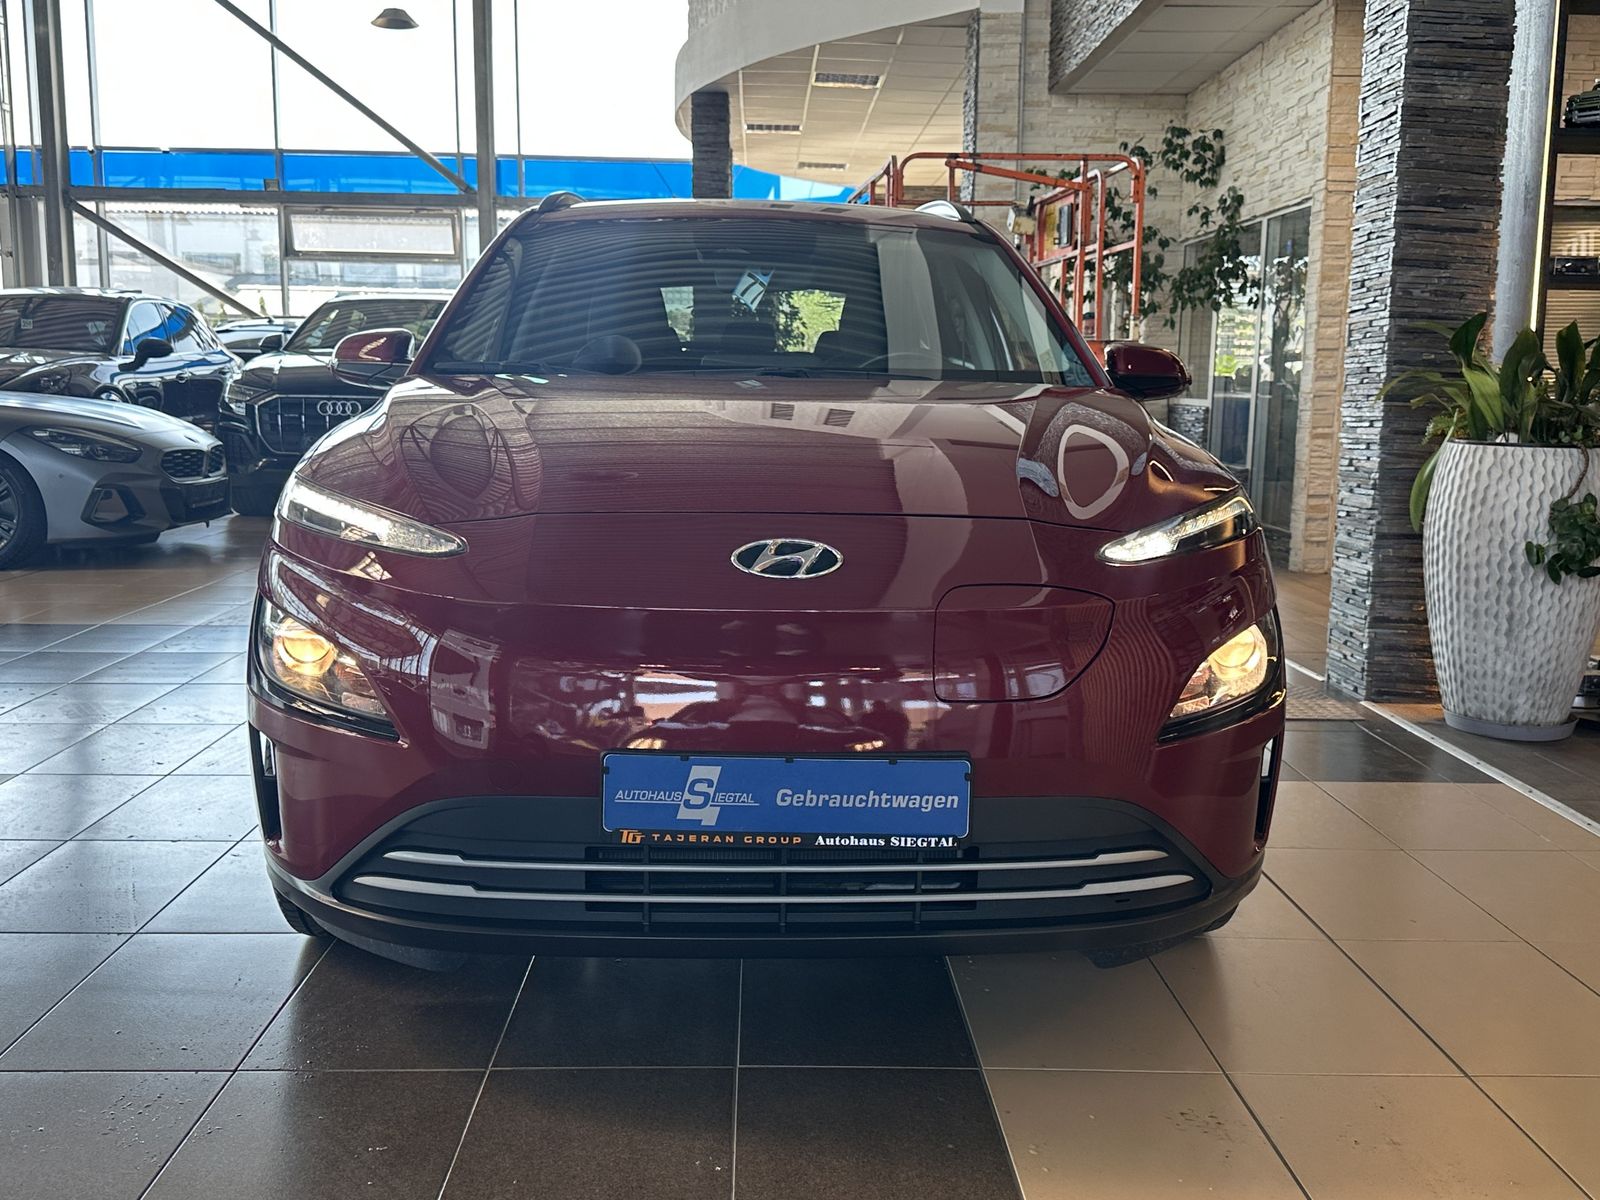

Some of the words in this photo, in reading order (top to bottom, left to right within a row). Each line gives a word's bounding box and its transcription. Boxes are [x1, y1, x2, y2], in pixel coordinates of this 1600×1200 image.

[615, 790, 682, 801] AUTOHAUS
[776, 789, 959, 812] Gebrauchtwagen
[652, 833, 734, 843] TAJERAN
[744, 836, 802, 845] GROUP
[815, 835, 889, 847] Autohaus
[890, 836, 957, 848] SIEGTAL
